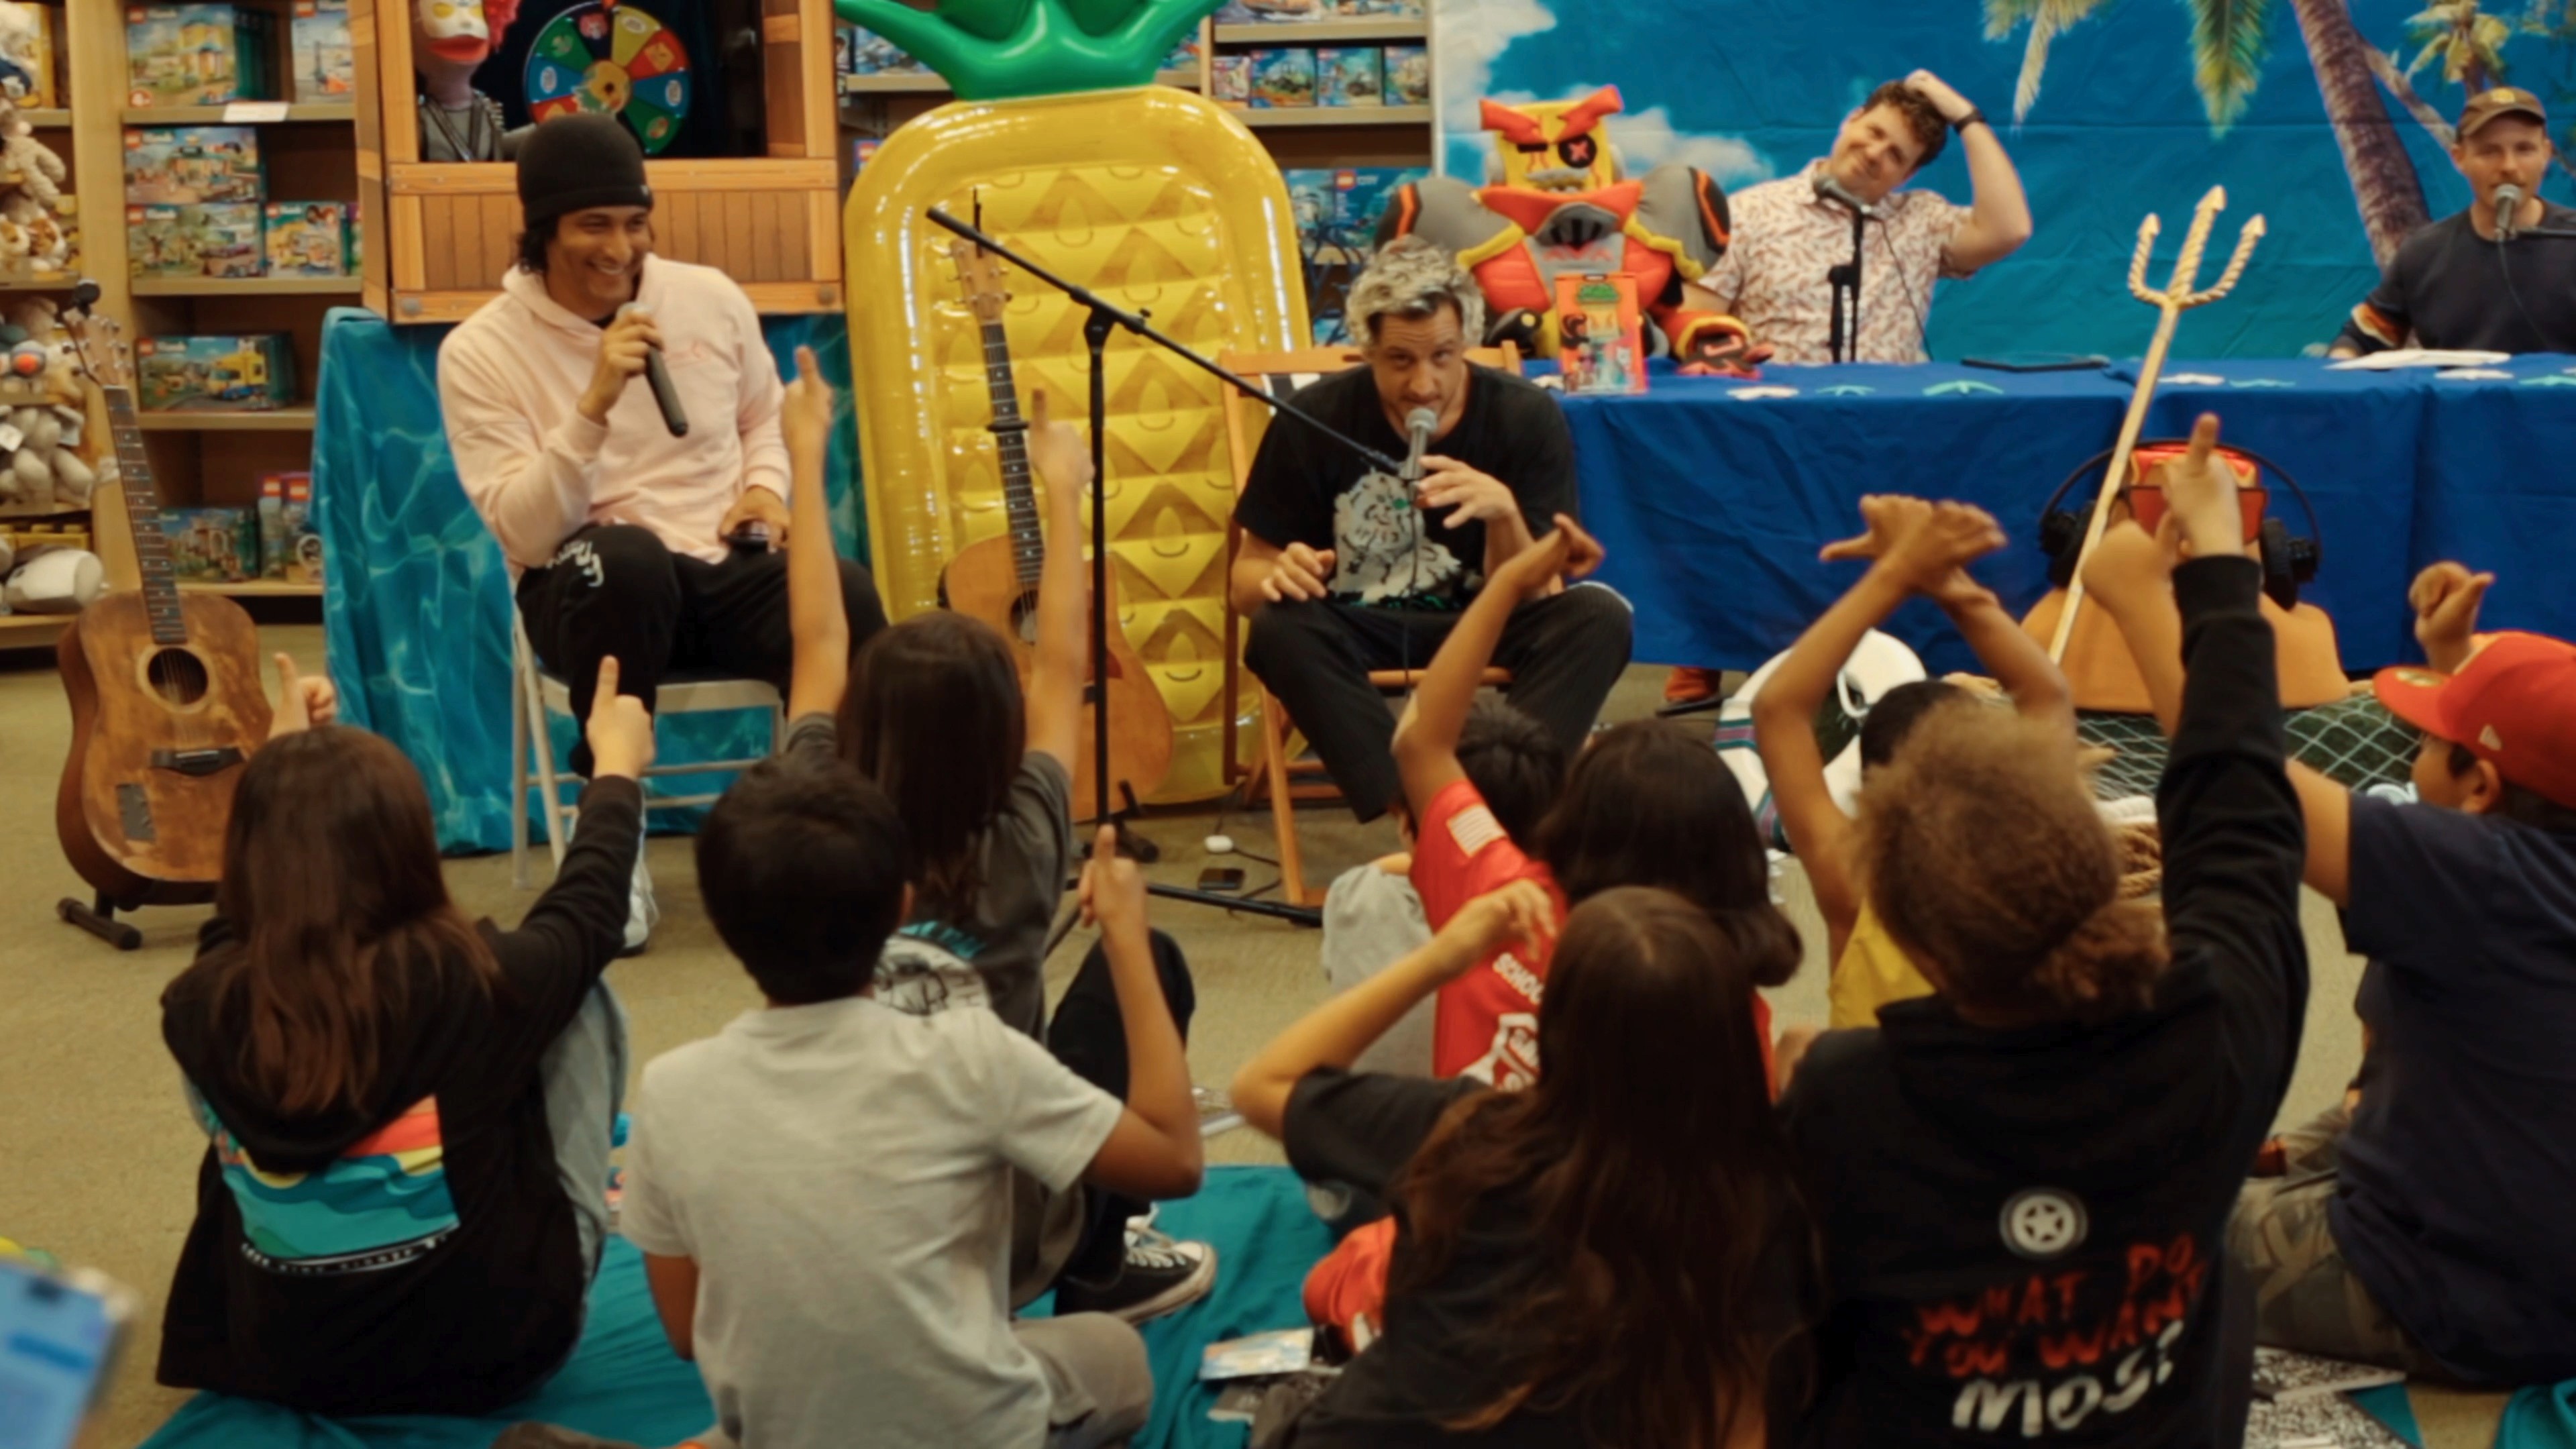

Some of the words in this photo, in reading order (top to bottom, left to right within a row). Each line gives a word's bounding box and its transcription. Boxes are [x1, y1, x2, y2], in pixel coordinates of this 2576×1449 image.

[1492, 952, 1545, 1005] SCHOO
[1919, 1272, 2088, 1337] WHAT
[2126, 1233, 2194, 1293] DO
[1901, 1327, 2012, 1378] YOU
